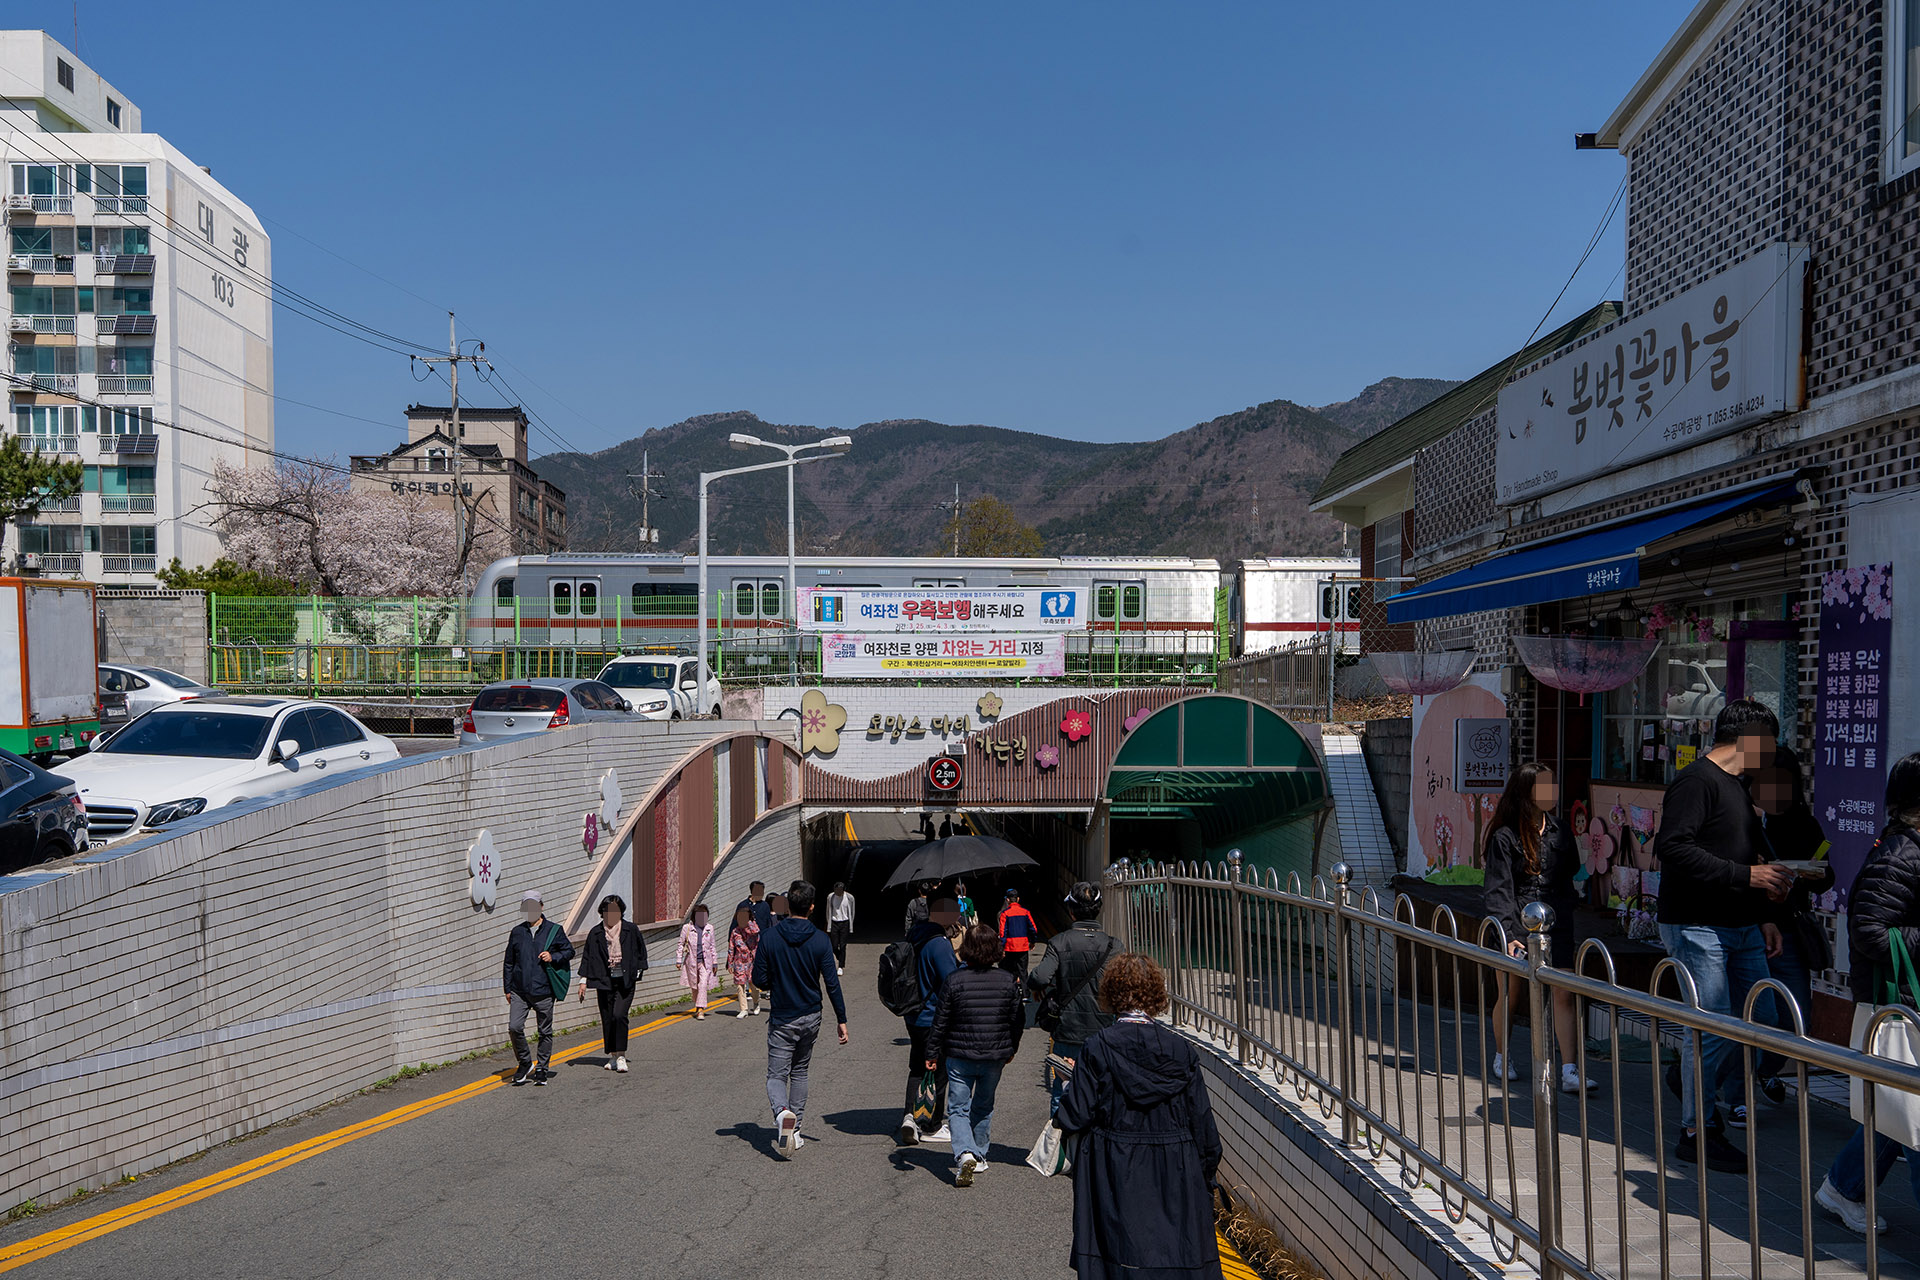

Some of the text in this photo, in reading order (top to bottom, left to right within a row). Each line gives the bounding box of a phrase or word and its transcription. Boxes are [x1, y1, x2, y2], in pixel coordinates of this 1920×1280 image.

[212, 272, 235, 308] 103
[1567, 295, 1740, 445] 봄벚꽃마을
[1663, 394, 1764, 441] 수공예공방 T.055.546.4234
[1514, 474, 1541, 494] Handmade
[1543, 470, 1559, 483] Shop
[1586, 567, 1621, 589] 봄벚꽃마을
[860, 600, 1025, 620] 여좌천 우측보행 해주세요
[864, 639, 1044, 657] 여좌천로 양편 차없는 거리 지정
[1827, 649, 1881, 672] 벚꽃 우산
[1826, 674, 1880, 696] 벚꽃 화관
[1826, 698, 1879, 720] 벚꽃 식혜
[867, 713, 971, 739] 로망스 다리
[936, 769, 956, 778] 2.5m
[1464, 761, 1505, 778] 봄벚꽃마을
[1838, 799, 1876, 816] 수공예공방
[1837, 818, 1875, 835] 봄벚꽃마을
